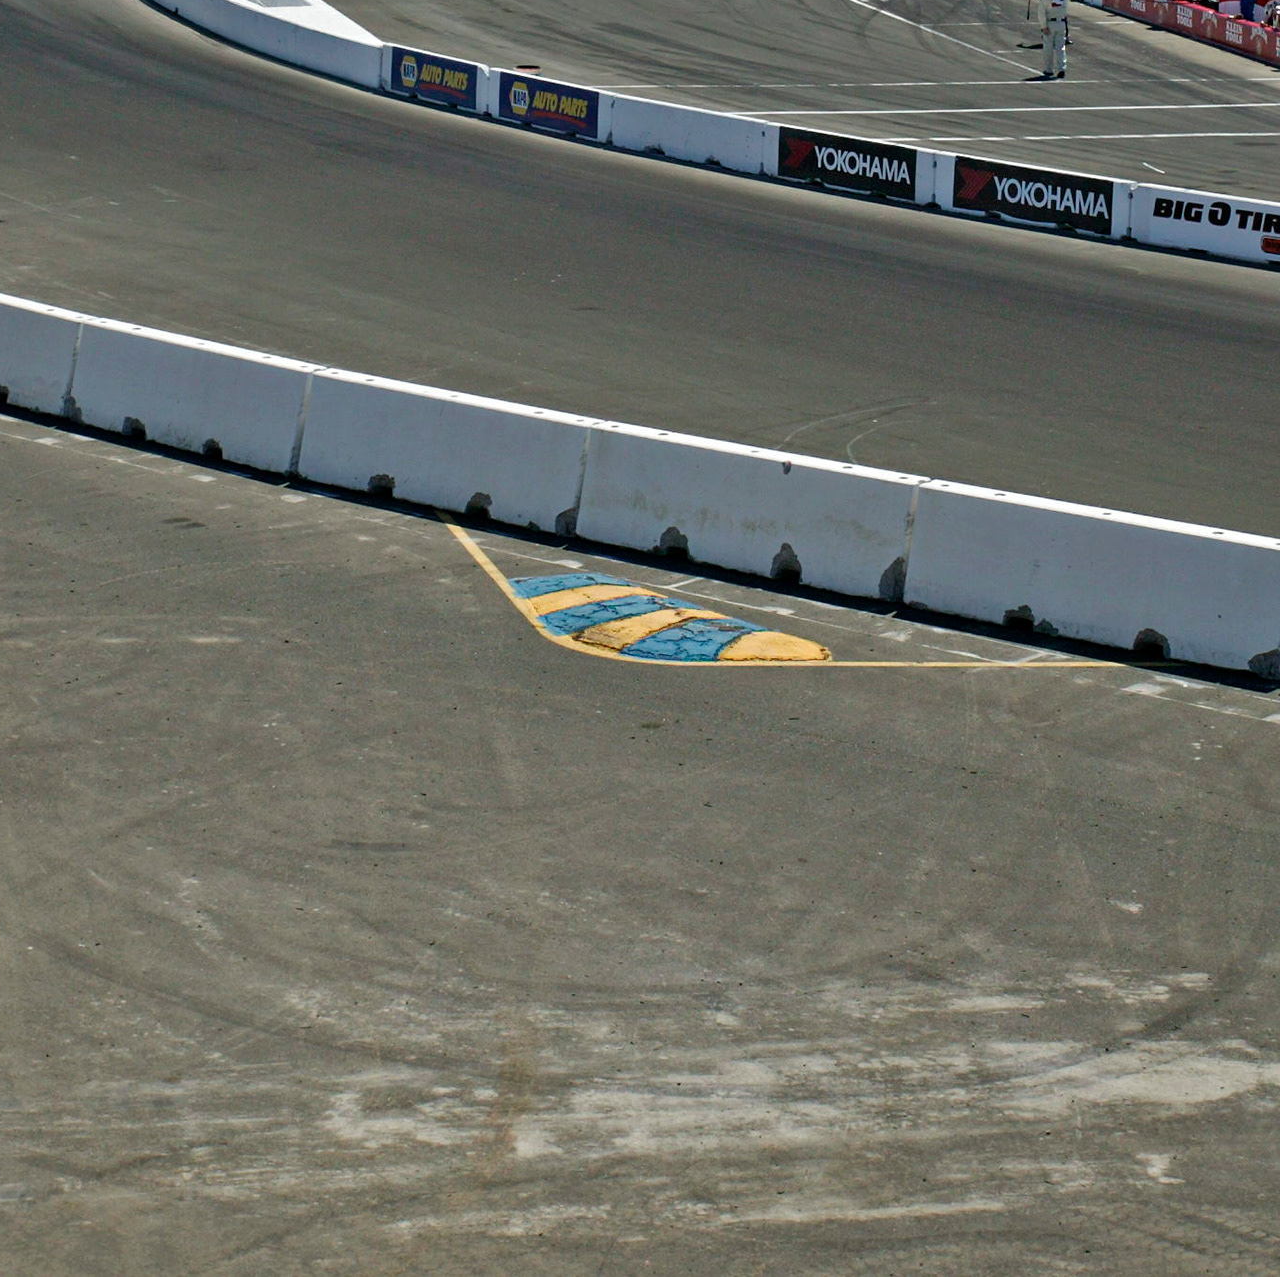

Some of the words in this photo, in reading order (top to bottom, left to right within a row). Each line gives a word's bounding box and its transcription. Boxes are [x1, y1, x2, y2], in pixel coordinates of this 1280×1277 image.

[420, 63, 442, 85] AUTO
[443, 68, 469, 91] PARTS
[512, 88, 528, 108] NAPA
[532, 90, 558, 111] AUTO
[558, 96, 589, 119] PARTS
[814, 145, 911, 185] YOKOHAMA
[993, 175, 1110, 220] YOKOHAMA
[1153, 197, 1204, 224] BIG
[1207, 201, 1232, 227] O
